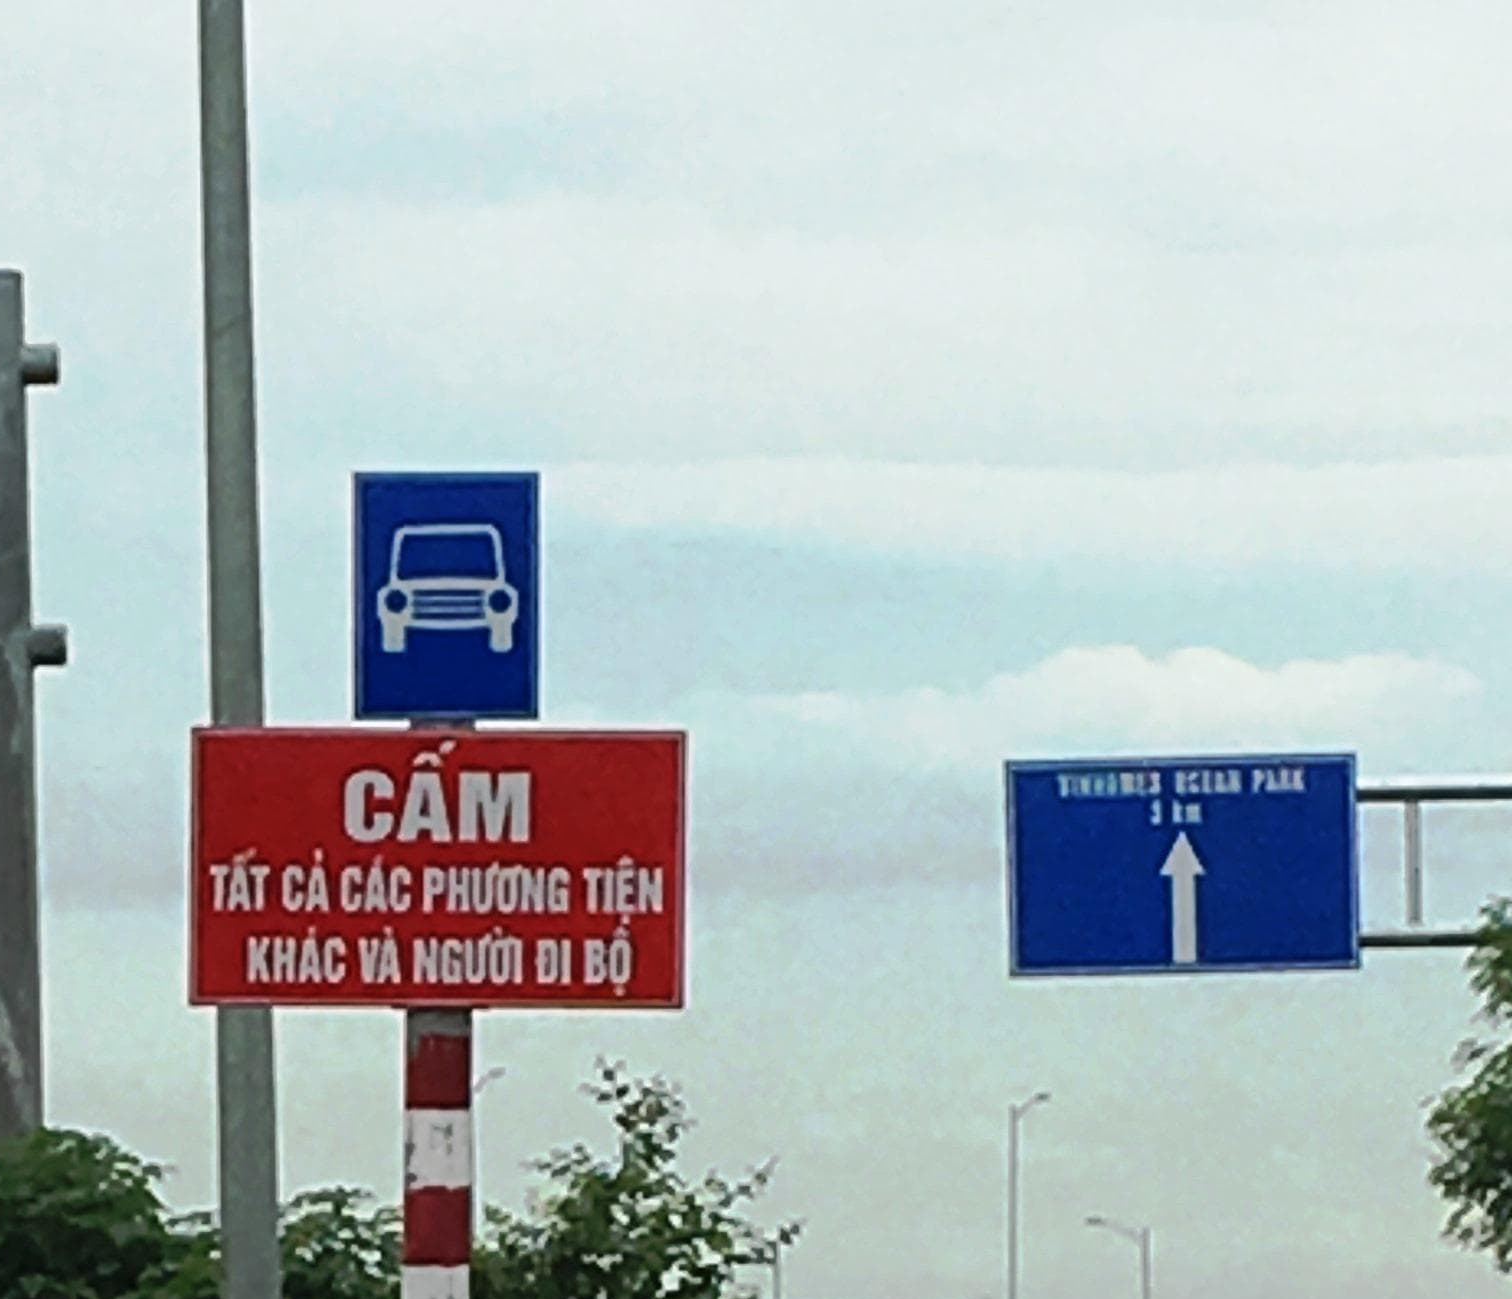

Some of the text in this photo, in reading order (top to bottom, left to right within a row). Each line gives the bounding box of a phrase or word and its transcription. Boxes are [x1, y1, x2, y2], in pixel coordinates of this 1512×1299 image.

[343, 740, 532, 844] CẤM
[1251, 767, 1306, 792] PARK
[209, 849, 664, 924] TẤT CẢ CÁC PHƯƠNG TIỆN
[245, 922, 633, 996] KHÁC VÀ NGƯỜI ĐI BỘ
